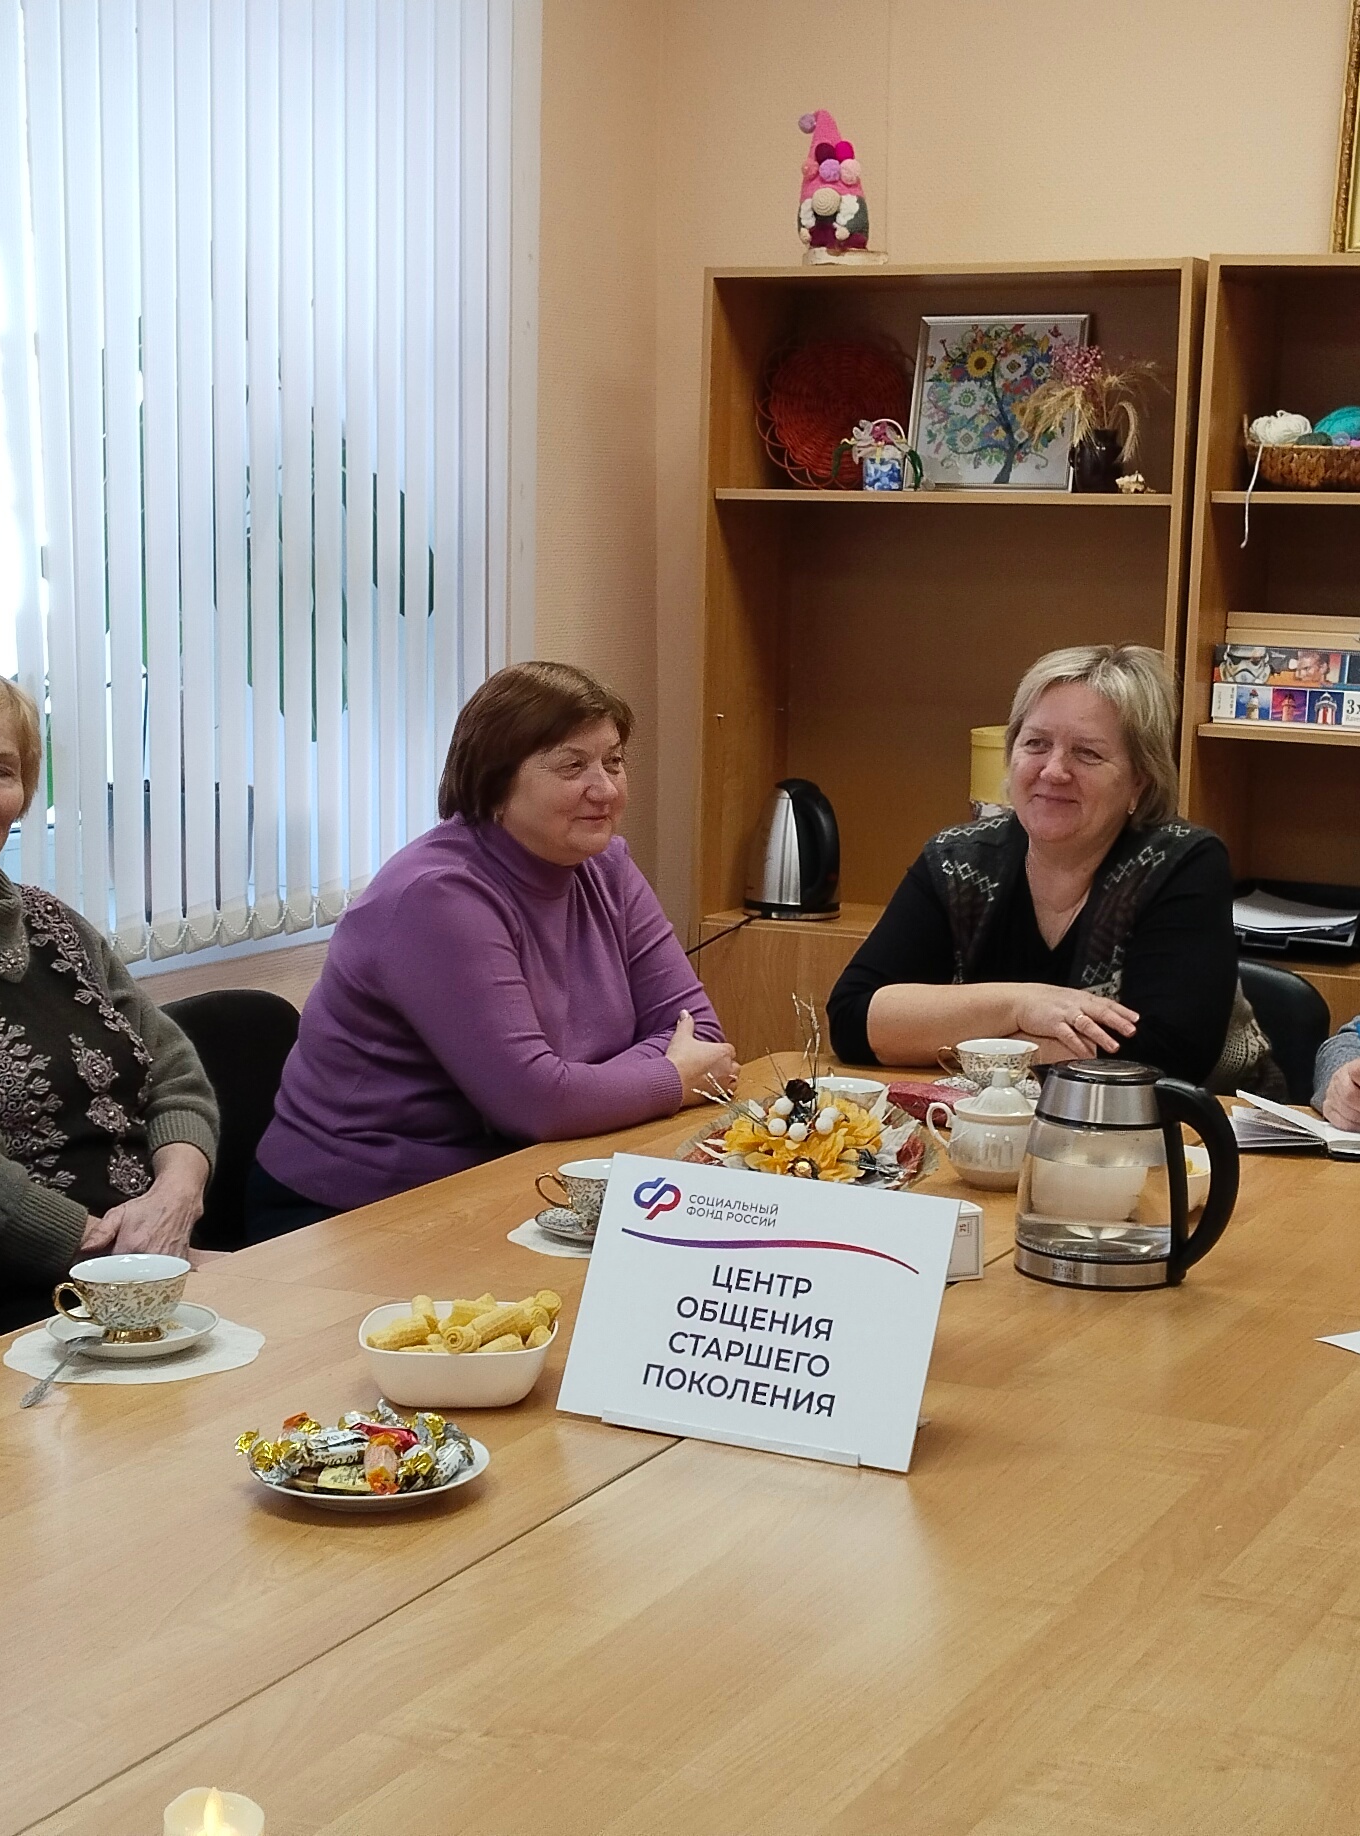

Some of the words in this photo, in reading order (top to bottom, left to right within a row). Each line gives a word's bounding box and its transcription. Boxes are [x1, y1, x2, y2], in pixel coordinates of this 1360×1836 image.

[686, 1207, 723, 1221] ФОНД
[726, 1212, 776, 1228] РОССИИ
[689, 1194, 779, 1215] СОЦИАЛЬНЫЙ
[711, 1264, 813, 1299] ЦЕНТР
[676, 1296, 834, 1342] ОБЩЕНИЯ
[668, 1331, 830, 1378] СТАРШЕГО
[642, 1363, 836, 1418] ПОКОЛЕНИЯ
